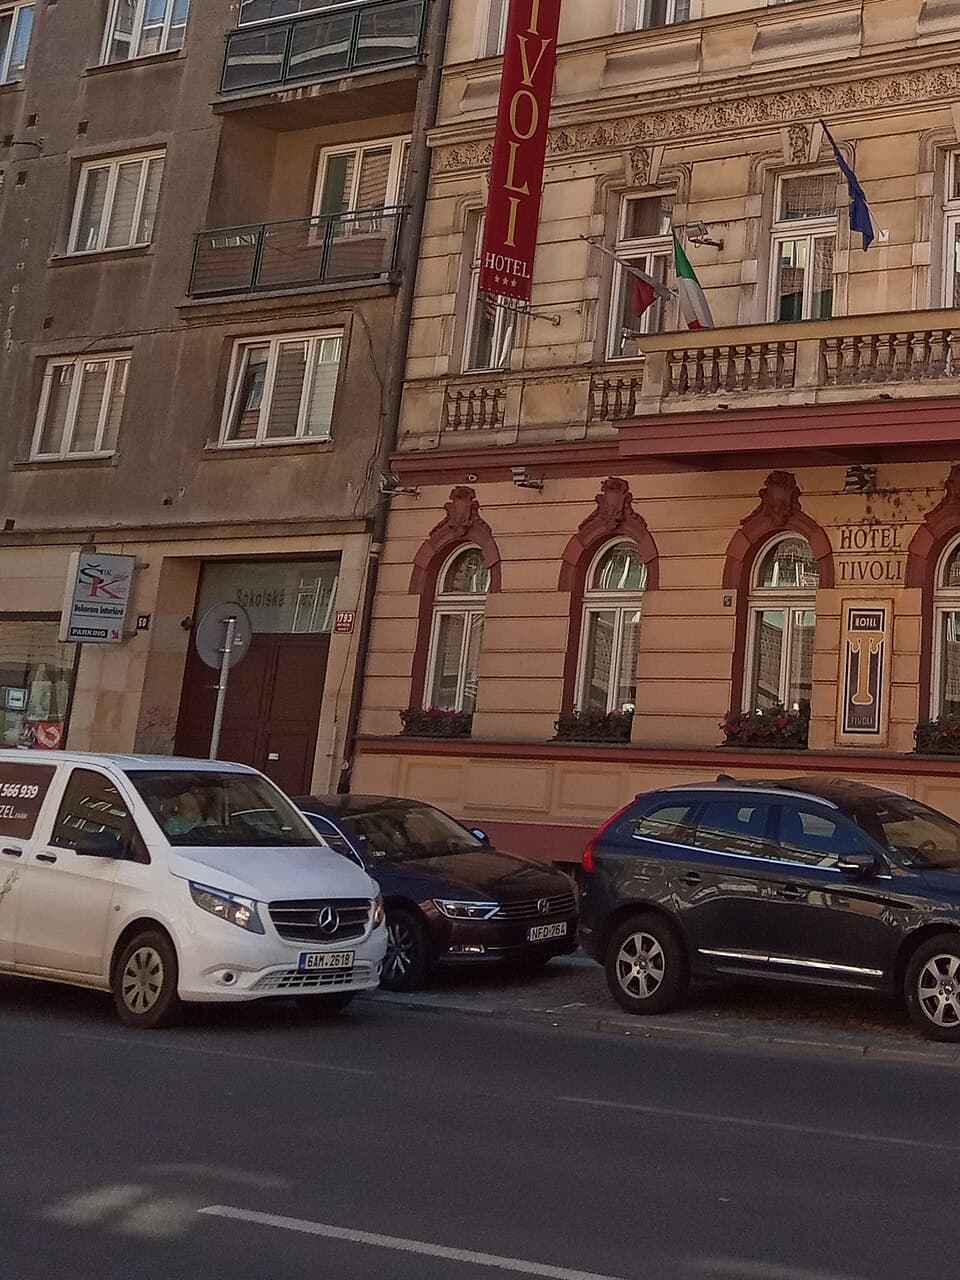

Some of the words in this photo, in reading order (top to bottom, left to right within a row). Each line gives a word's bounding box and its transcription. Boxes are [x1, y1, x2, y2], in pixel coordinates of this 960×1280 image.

[485, 253, 531, 279] HOTEL
[840, 528, 901, 549] HOTEL
[839, 561, 902, 580] TIVOLI
[72, 628, 106, 637] PARKING
[19, 784, 39, 799] 939
